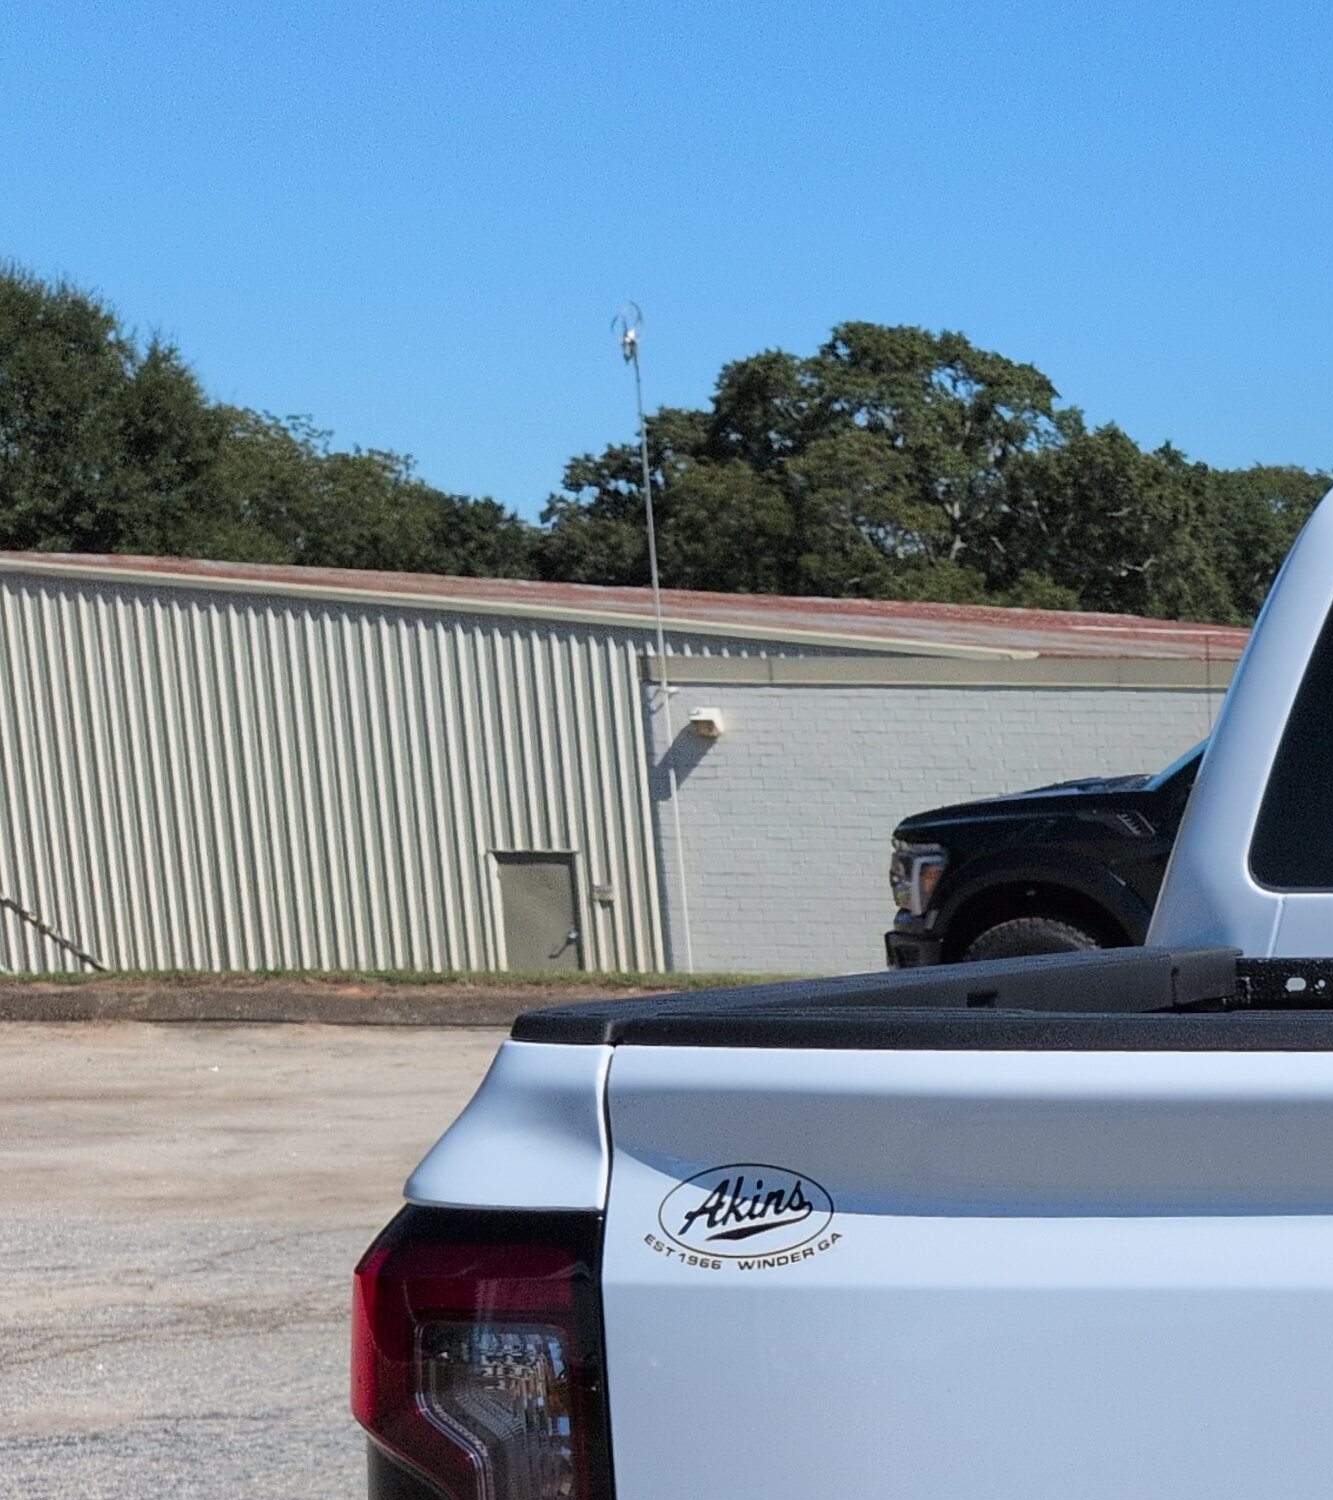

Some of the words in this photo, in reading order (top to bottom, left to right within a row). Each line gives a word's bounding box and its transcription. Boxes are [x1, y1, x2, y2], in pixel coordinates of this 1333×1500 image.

[677, 1176, 813, 1237] Akins
[643, 1233, 676, 1257] EST
[678, 1253, 722, 1270] 1966
[737, 1247, 815, 1270] WINDER
[817, 1232, 843, 1251] GA
